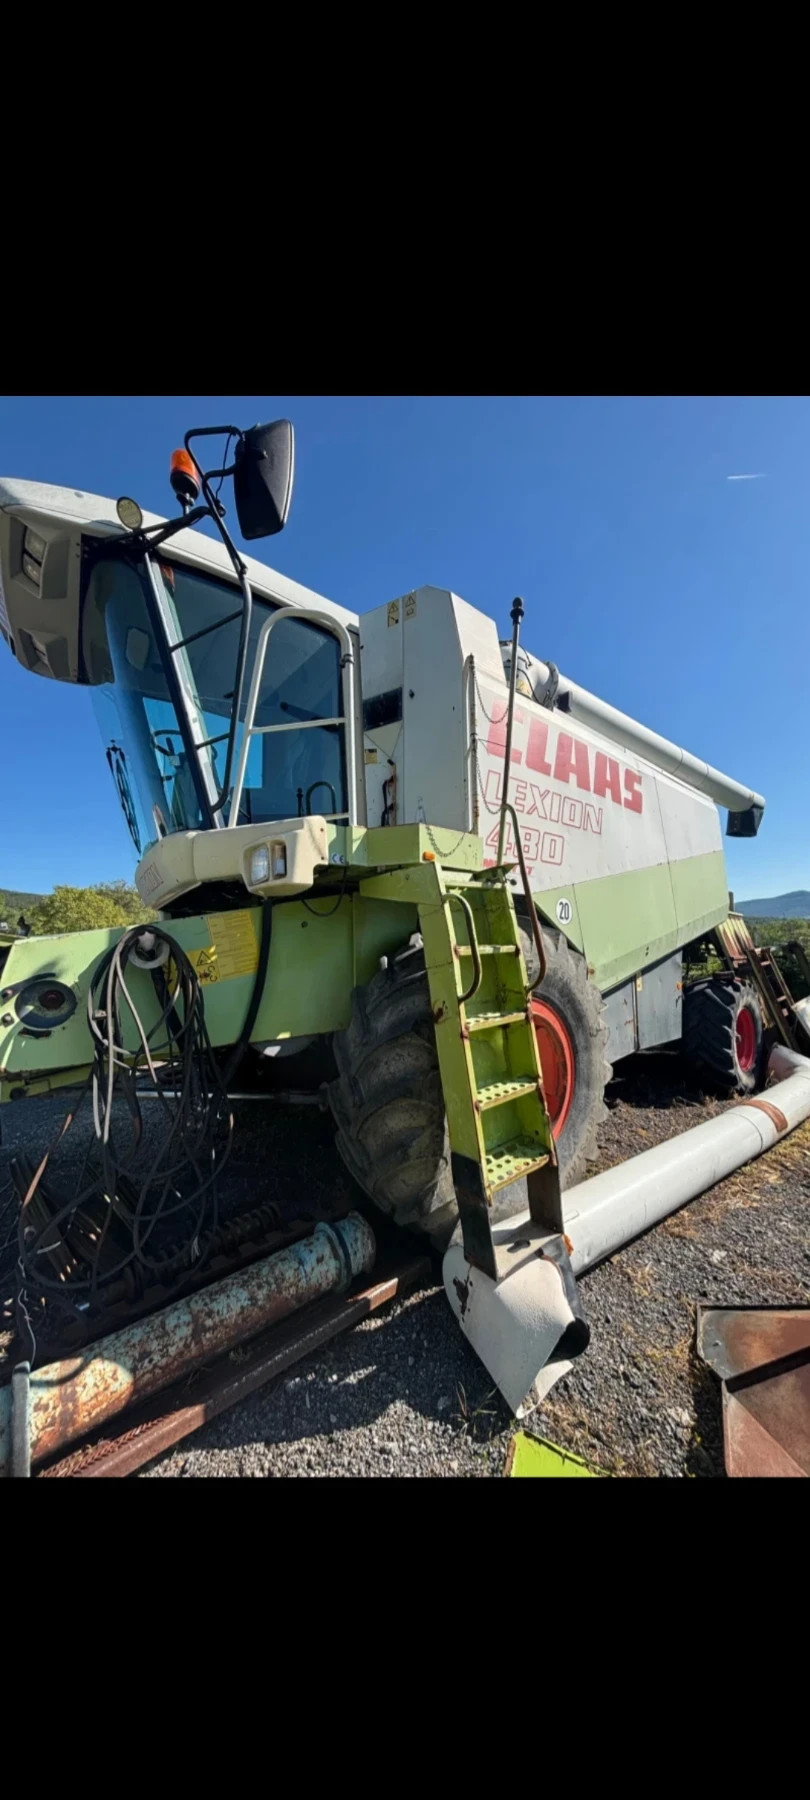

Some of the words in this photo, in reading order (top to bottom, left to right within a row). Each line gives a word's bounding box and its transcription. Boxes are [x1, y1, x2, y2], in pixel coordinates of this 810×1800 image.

[486, 697, 643, 815] CLAAS
[485, 769, 603, 835] LEXION
[485, 820, 565, 866] 480
[559, 901, 570, 920] 20
